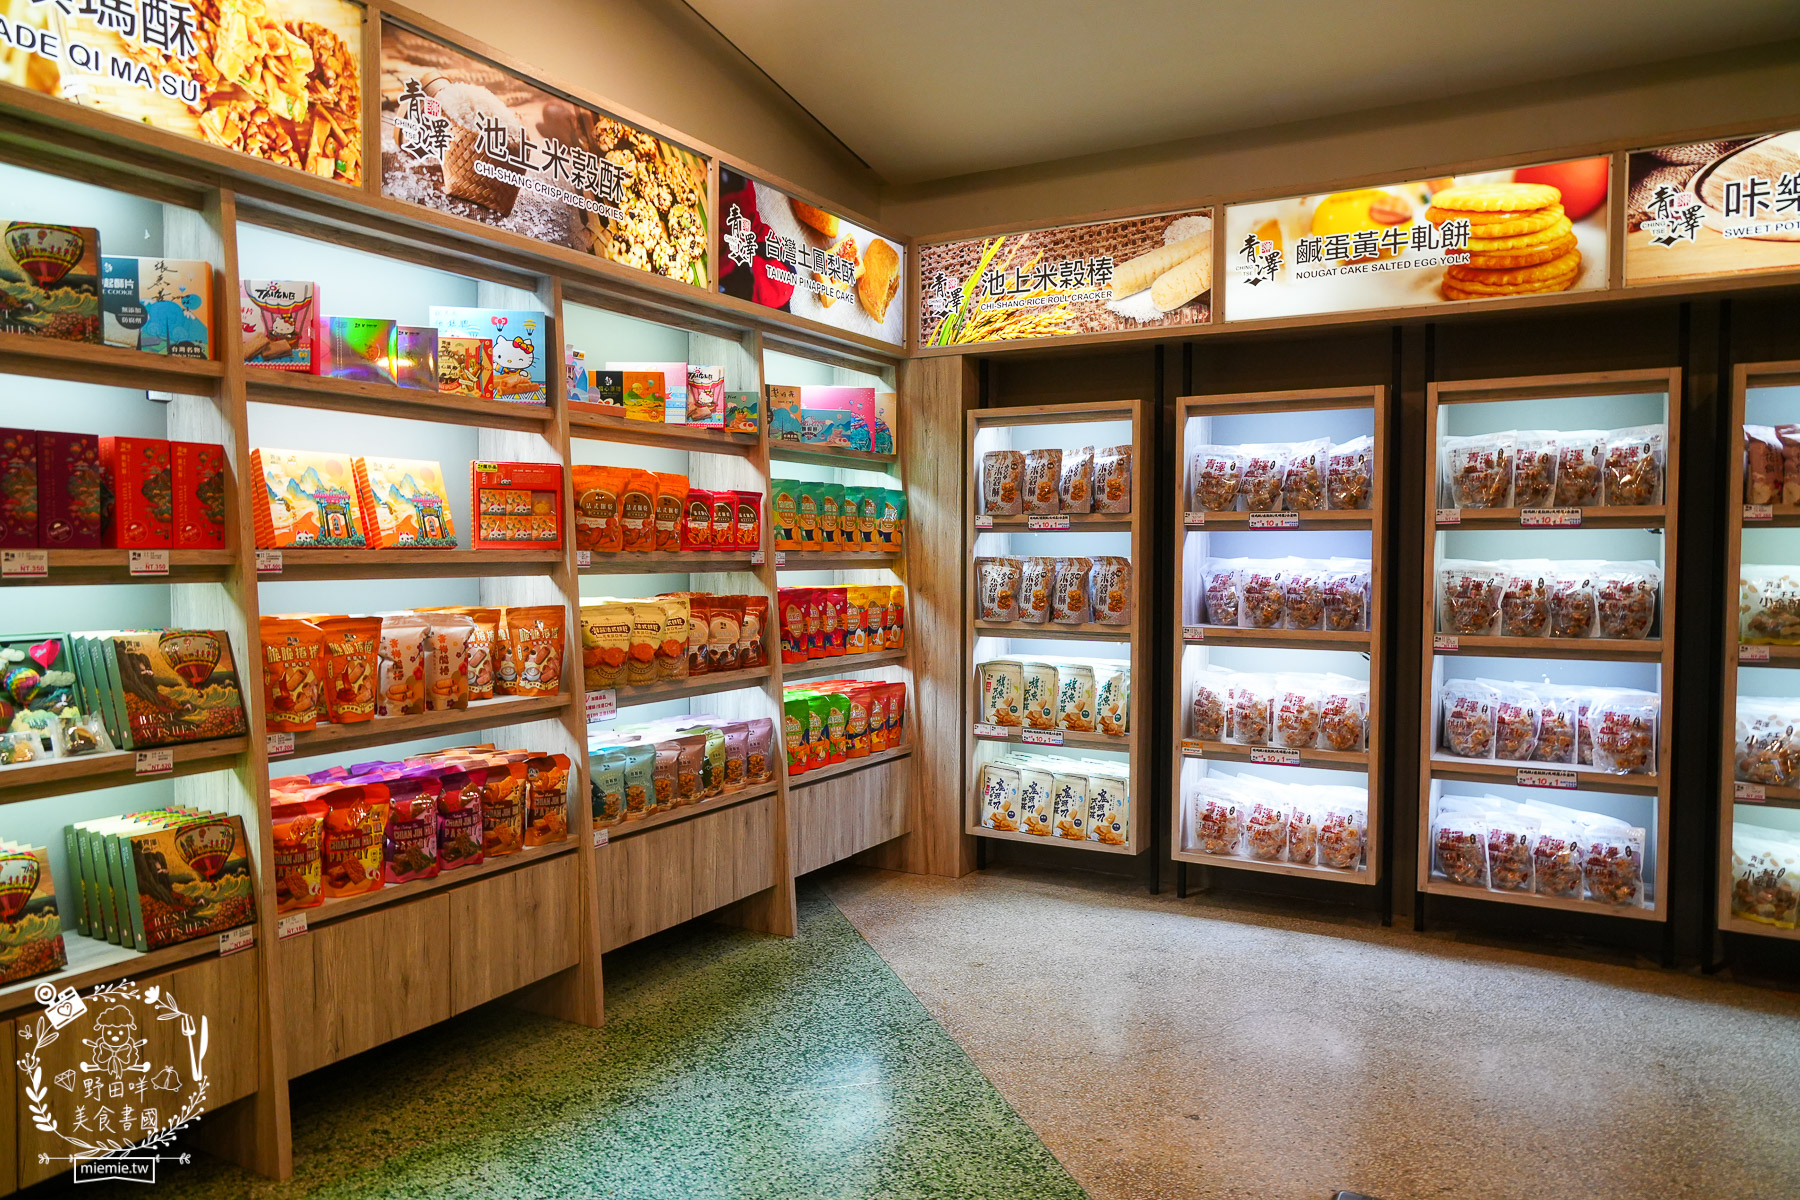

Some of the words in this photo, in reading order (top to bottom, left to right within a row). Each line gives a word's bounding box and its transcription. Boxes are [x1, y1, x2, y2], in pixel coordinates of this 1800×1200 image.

[31, 0, 197, 54] 瑪酥
[69, 44, 100, 71] QI
[111, 57, 153, 90] MA
[162, 75, 198, 101] SU
[475, 114, 625, 202] 池上米穀酥
[475, 161, 532, 190] CHI-SHANG
[534, 183, 562, 202] CRISP
[563, 191, 585, 209] RICE
[586, 200, 625, 222] COOKIES
[1296, 220, 1471, 265] 鹹蛋黃牛軋餅
[1724, 225, 1771, 238] SWEET
[766, 231, 856, 286] 台灣土鳳梨酥
[981, 257, 1113, 297] 池上米穀棒
[1296, 267, 1338, 280] NOUGAT
[1340, 264, 1369, 276] CAKE
[1371, 261, 1411, 273] SALTED
[1414, 257, 1437, 267] EGG
[1439, 252, 1470, 265] YOLK
[766, 264, 797, 286] TAIWAN
[799, 278, 834, 298] PINAPPLE
[836, 289, 855, 305] CAKE
[981, 300, 1025, 311] CHI-SHANG
[1026, 297, 1046, 306] RICE
[1047, 294, 1069, 305] ROLL
[1071, 290, 1112, 302] CRACKER
